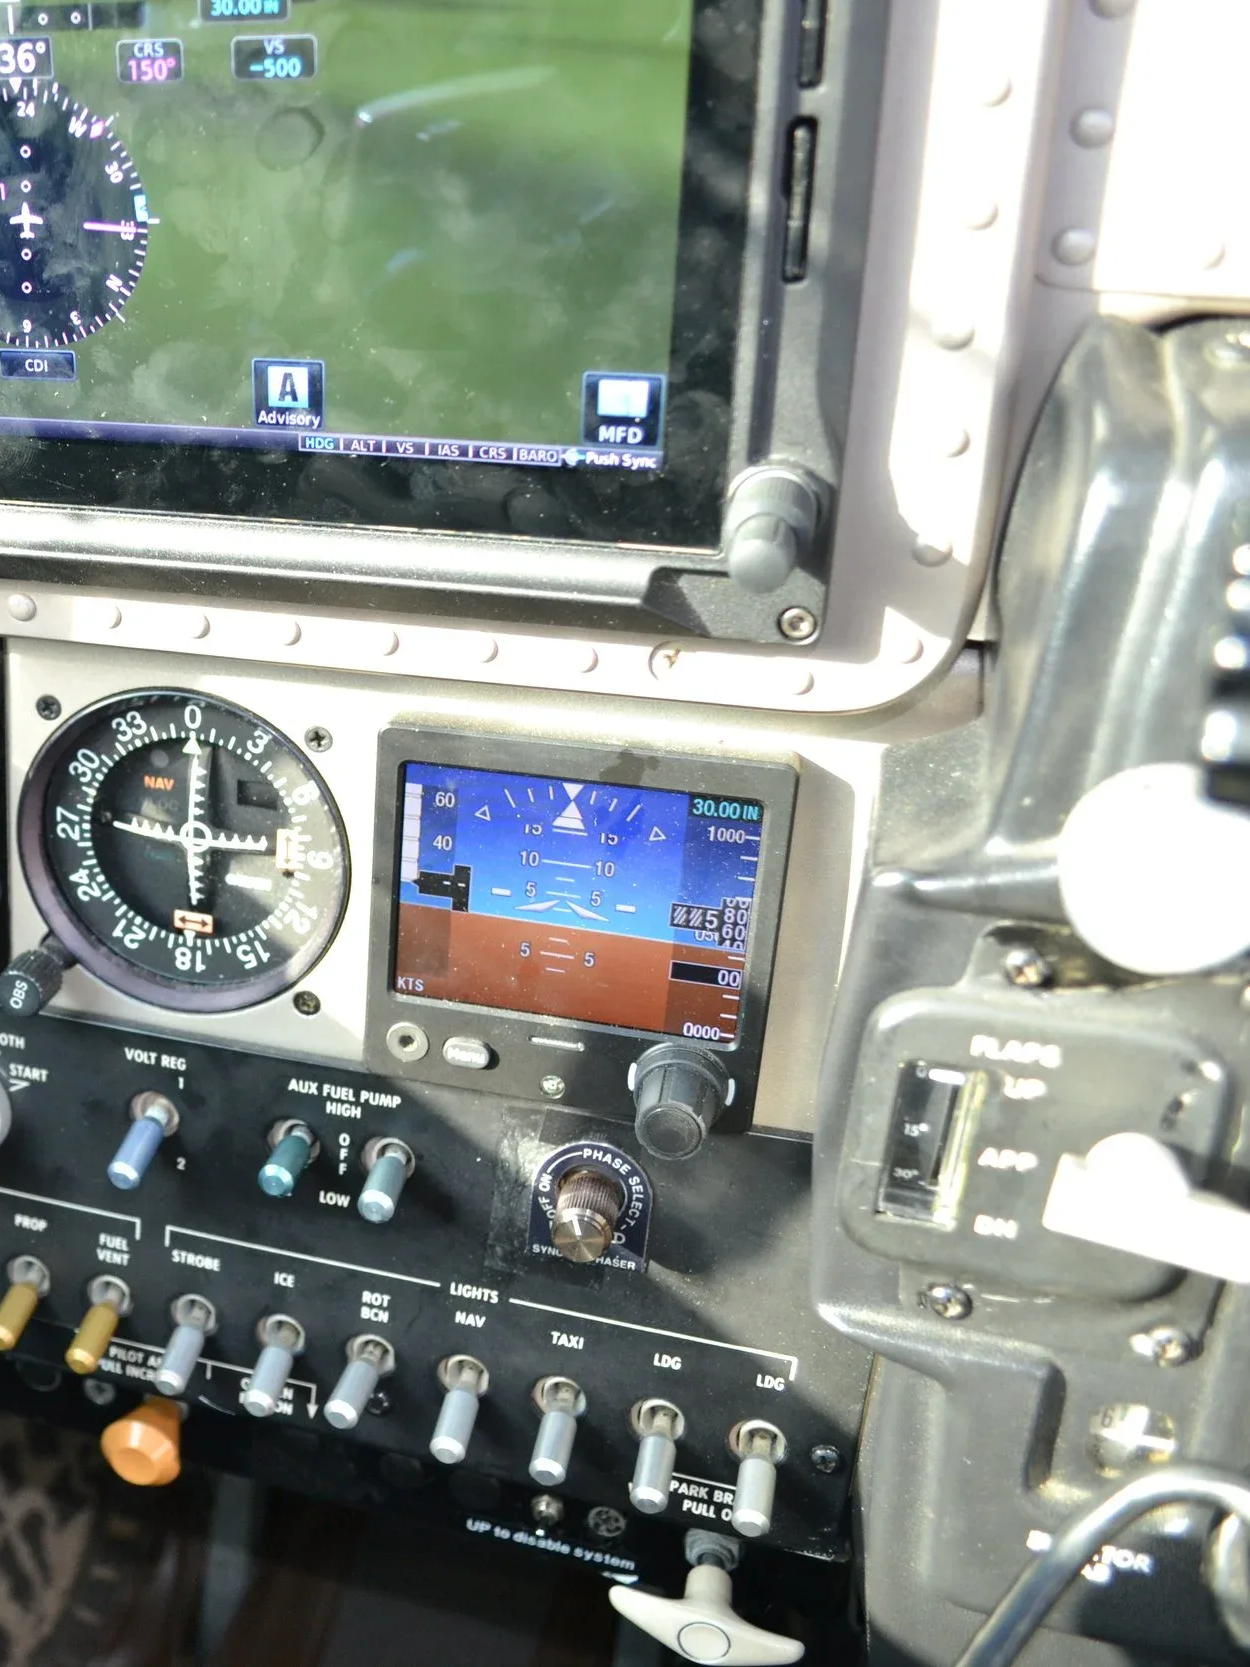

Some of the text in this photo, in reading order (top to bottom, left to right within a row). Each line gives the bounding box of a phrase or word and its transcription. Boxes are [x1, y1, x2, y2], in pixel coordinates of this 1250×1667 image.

[133, 43, 164, 58] CRS
[262, 40, 286, 54] VS
[128, 58, 176, 81] 150°
[249, 58, 301, 79] -500
[25, 359, 49, 372] CDI
[258, 409, 321, 428] Advisory
[598, 425, 643, 445] MFD
[305, 438, 558, 463] HDG ALT VS IAS CRS BARO
[112, 711, 147, 741] 33
[69, 749, 100, 783] 30
[144, 775, 175, 791] NAV
[435, 793, 456, 808] 60
[56, 806, 80, 841] 27
[433, 835, 453, 851] 40
[708, 826, 746, 844] 1000
[69, 869, 101, 901] 24
[112, 919, 146, 949] 21
[175, 947, 206, 973] 18
[10, 979, 28, 1009] OBS
[397, 977, 424, 993] KTS
[124, 1047, 187, 1071] VOLT REG
[8, 1063, 48, 1083] START
[288, 1078, 402, 1109] AUX FUEL PUMP
[325, 1101, 361, 1119] HIGH
[582, 1148, 645, 1228] PHASE SELECT
[319, 1190, 350, 1208] LOW
[14, 1214, 48, 1232] PROP
[99, 1232, 130, 1252] FUEL
[96, 1247, 130, 1267] VENT
[171, 1249, 221, 1272] STROBE
[273, 1271, 295, 1288] ICE
[361, 1290, 391, 1308] ROT
[449, 1282, 500, 1304] LIGHTS
[360, 1306, 390, 1324] BCN
[454, 1310, 486, 1328] NAV
[550, 1331, 585, 1350] TAXI
[653, 1353, 682, 1371] LDG
[756, 1374, 786, 1392] LDG
[669, 1480, 709, 1500] PARK
[682, 1500, 717, 1520] PULL
[466, 1518, 636, 1572] UP to disable system
